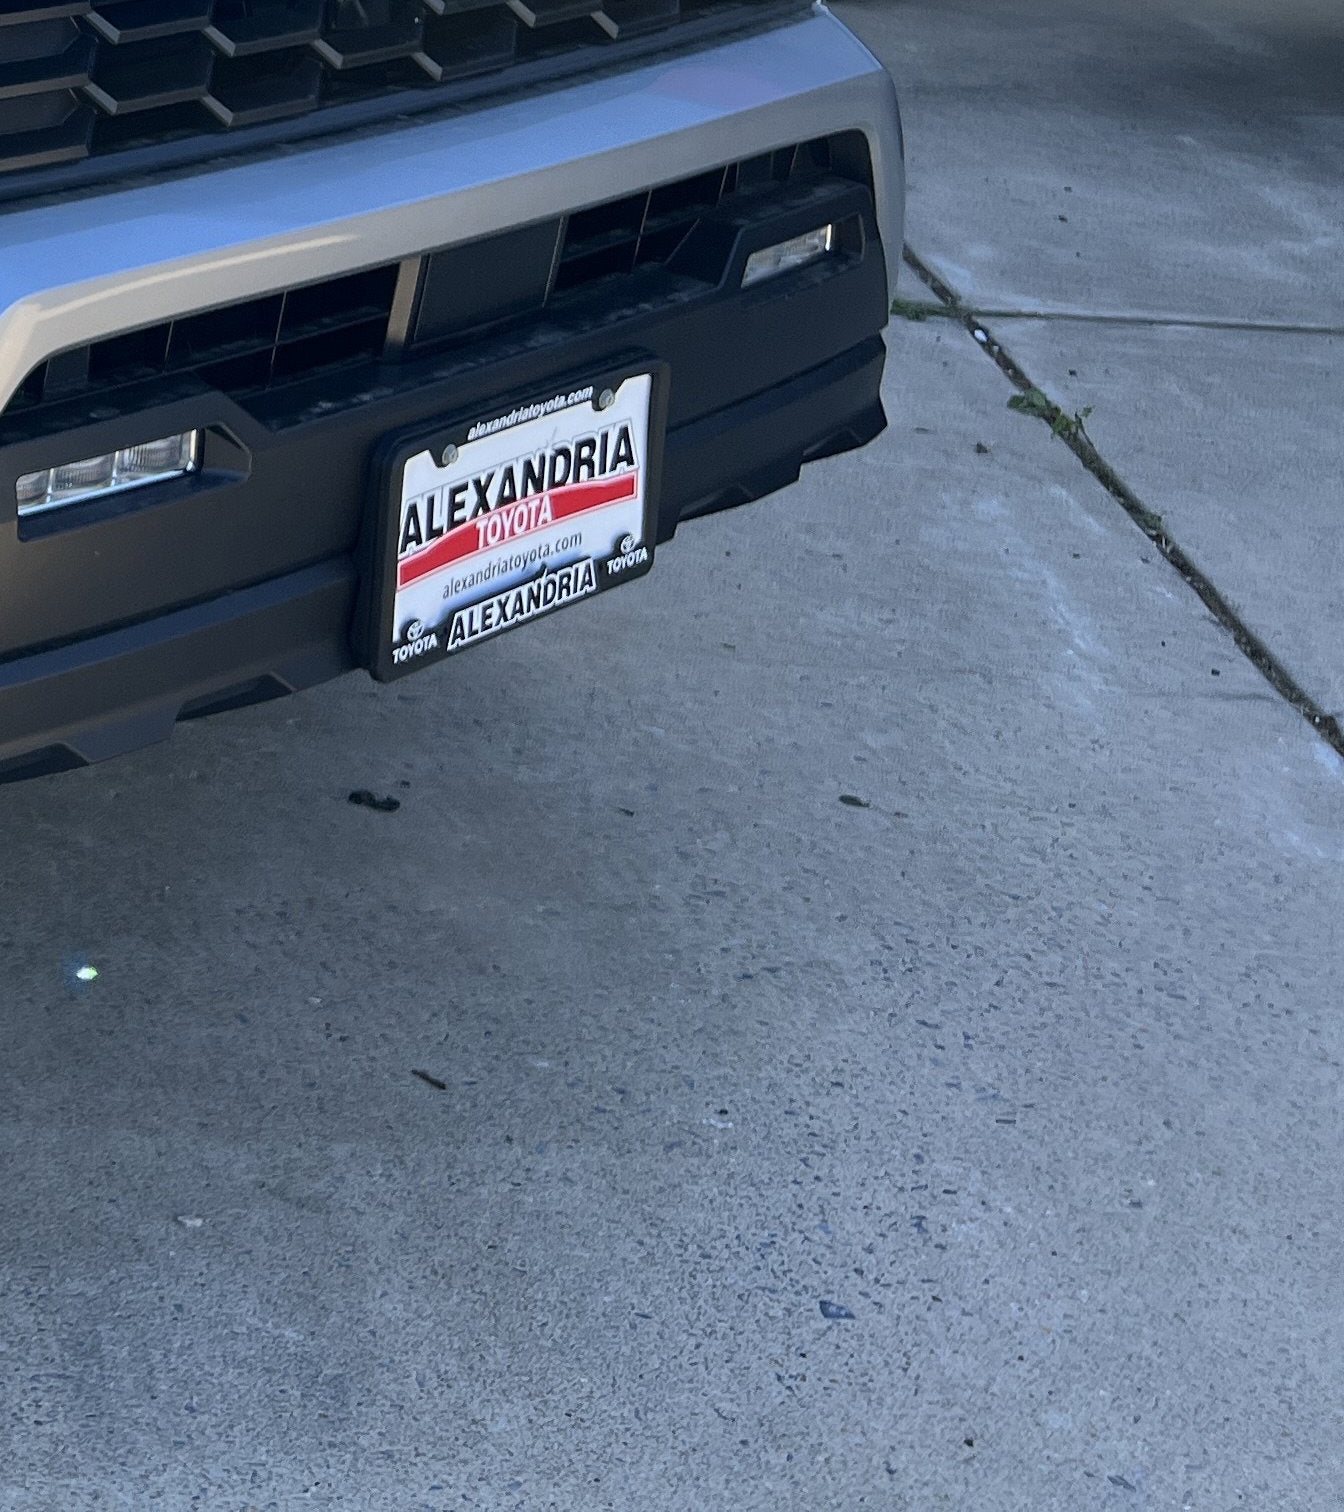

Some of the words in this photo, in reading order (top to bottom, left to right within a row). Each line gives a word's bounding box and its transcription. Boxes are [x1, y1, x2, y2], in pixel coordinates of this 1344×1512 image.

[467, 385, 594, 440] alexandriatoyota.com
[400, 424, 636, 555] ALEXANDRIA
[475, 494, 554, 550] TOYOTA
[442, 531, 583, 600] alexandriatoyota.com
[606, 548, 648, 575] TOYOTA
[449, 563, 596, 647] ALEXANDRIA
[392, 632, 438, 664] TOYOTA
